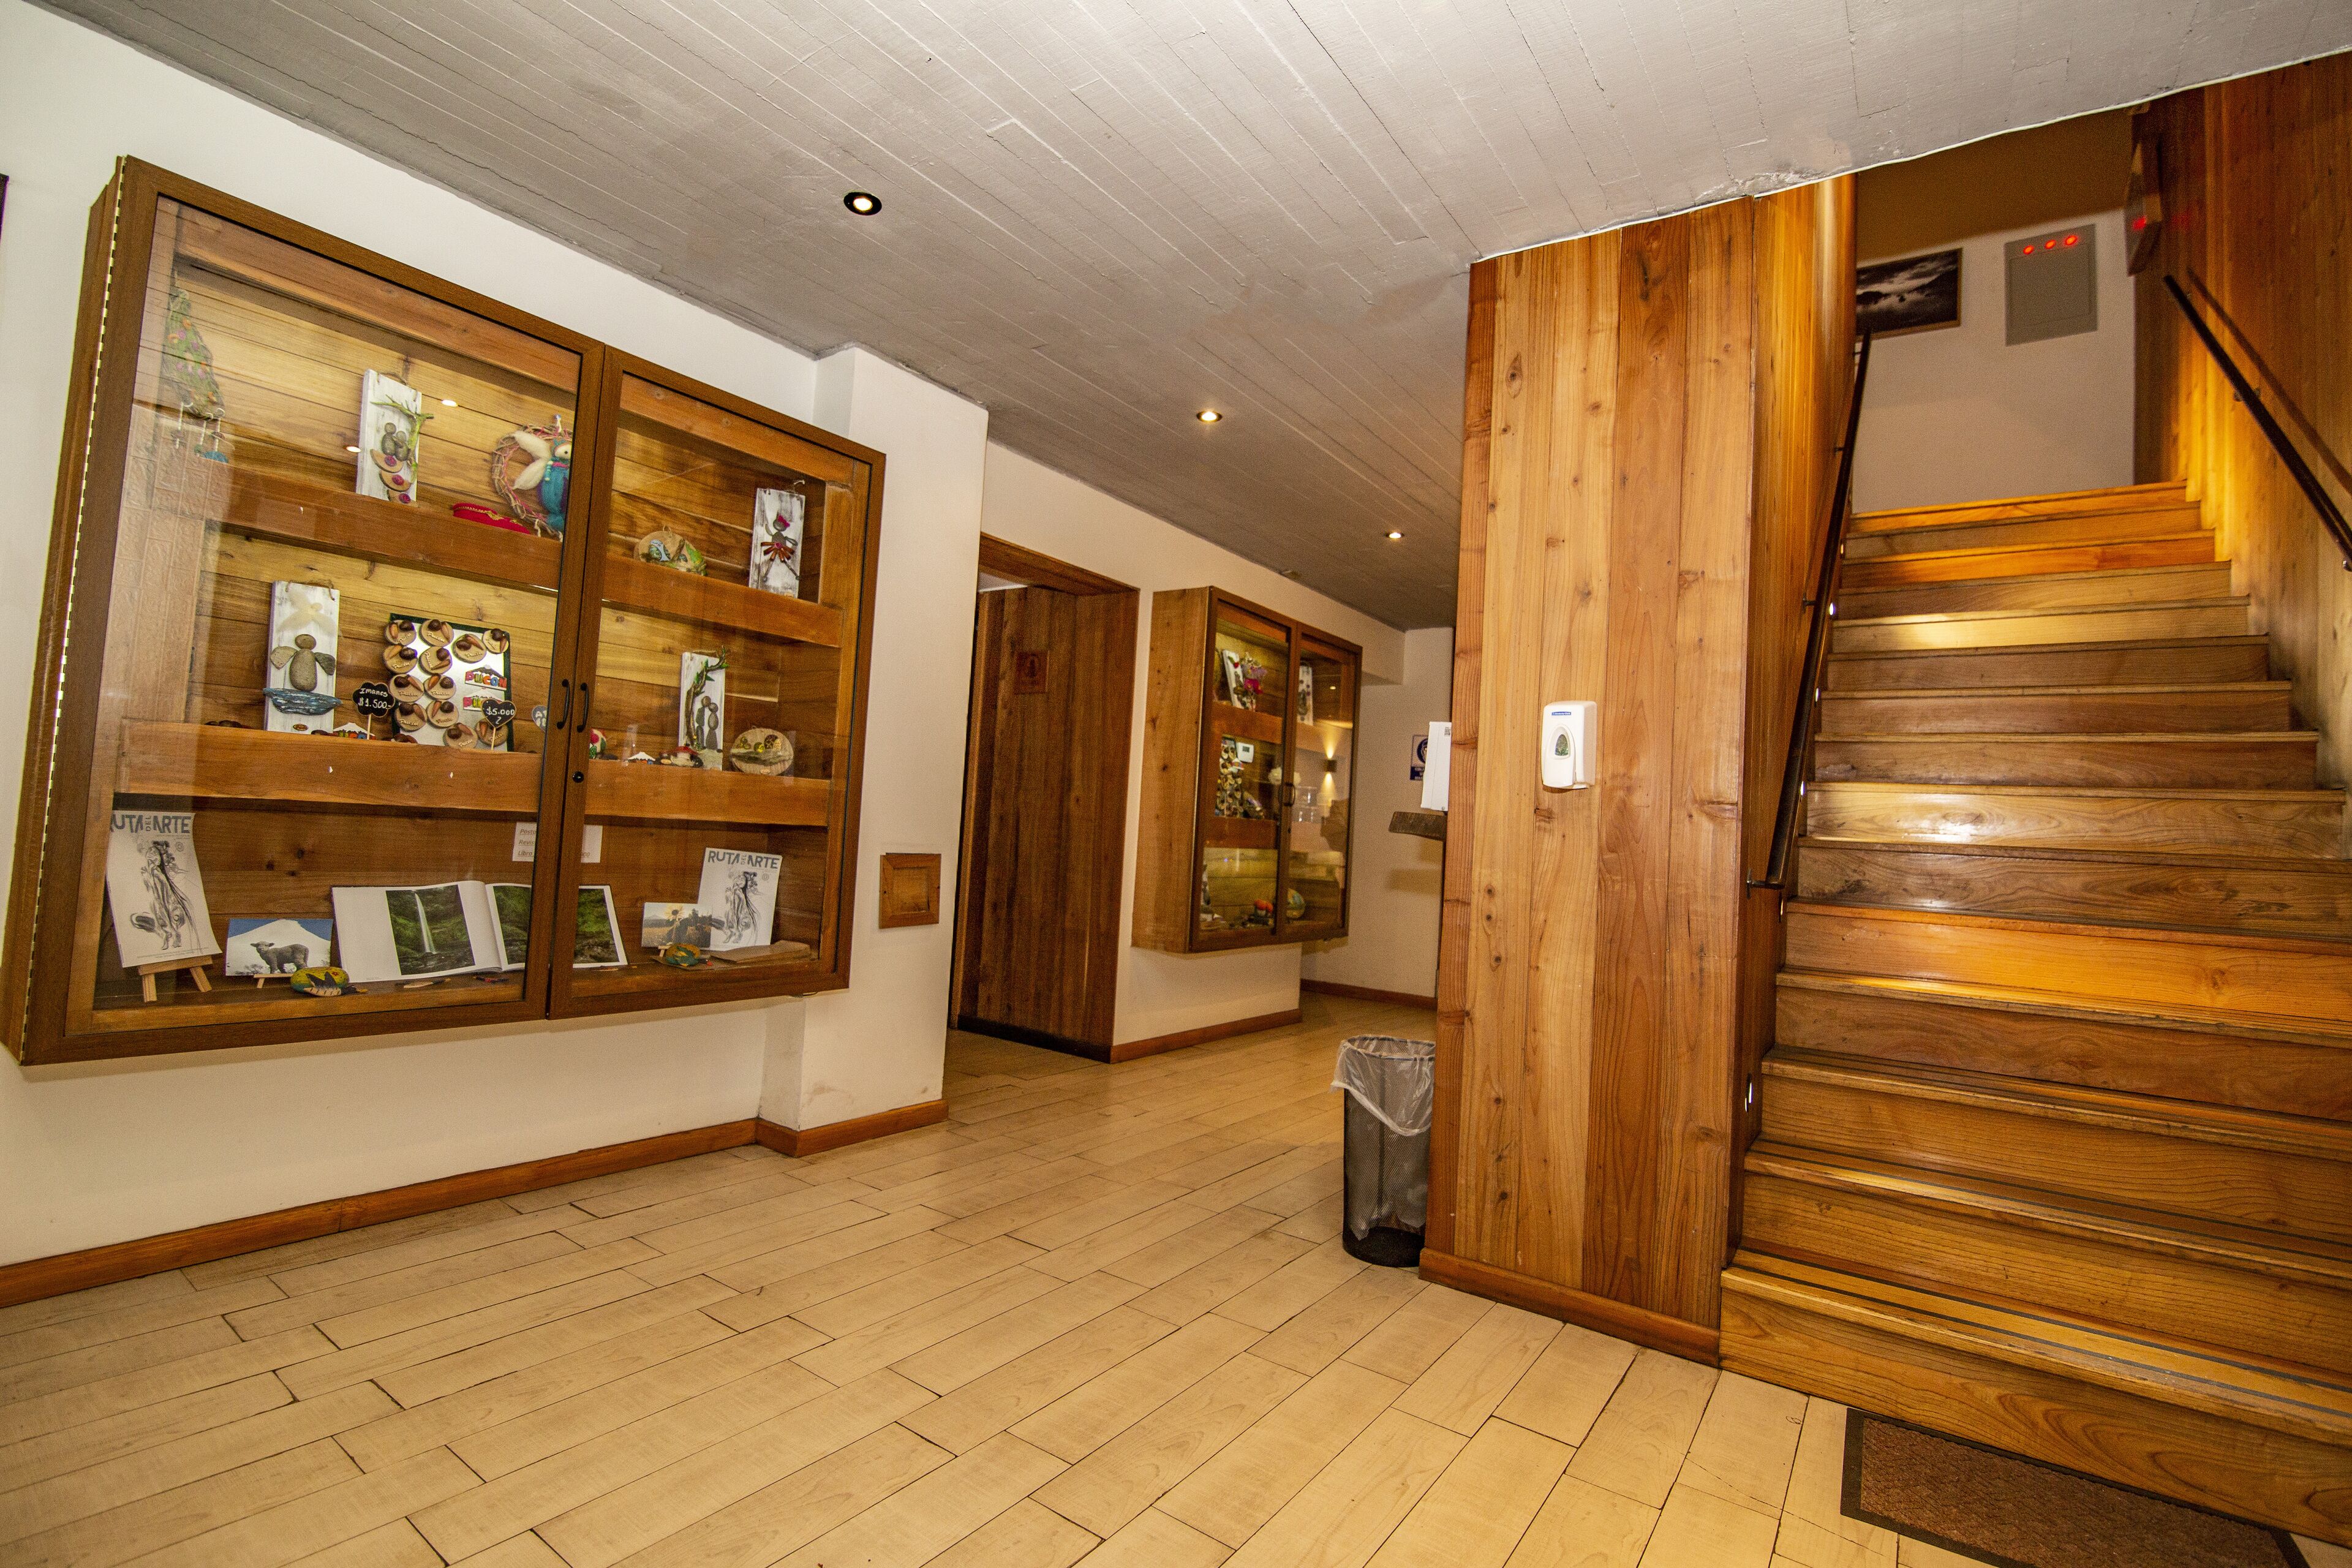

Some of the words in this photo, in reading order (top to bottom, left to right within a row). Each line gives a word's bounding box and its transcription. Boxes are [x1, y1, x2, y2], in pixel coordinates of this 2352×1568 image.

[360, 688, 388, 697] Imanes
[486, 706, 515, 716] $5.000
[153, 815, 192, 834] ARTE
[708, 851, 740, 864] RUTA
[747, 854, 779, 869] ARTE
